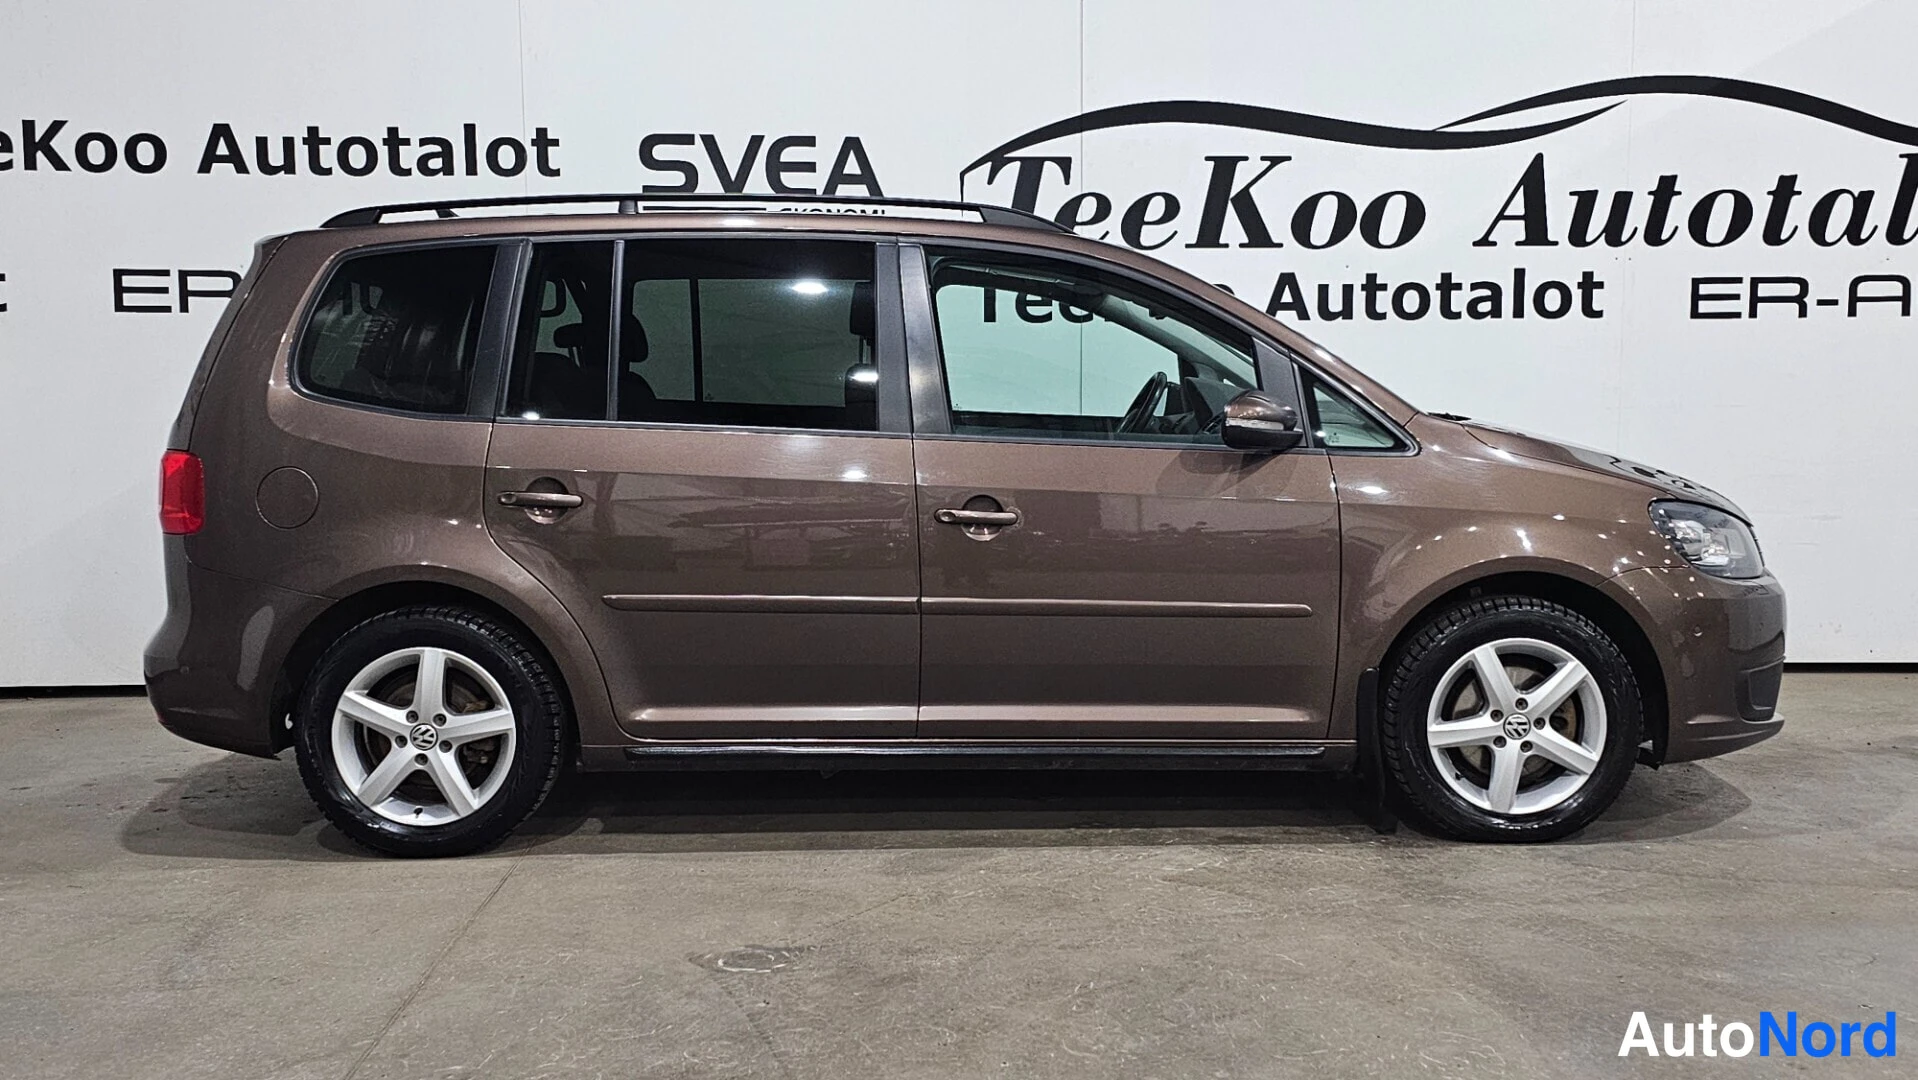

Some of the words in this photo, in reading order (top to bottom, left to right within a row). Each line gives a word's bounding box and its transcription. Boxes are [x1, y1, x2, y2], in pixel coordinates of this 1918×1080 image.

[197, 123, 561, 178] Autotalot
[639, 134, 885, 198] SVEA
[987, 155, 1427, 250] TeeKoo
[1265, 268, 1605, 321] Autotalot
[1689, 274, 1912, 320] ER-A
